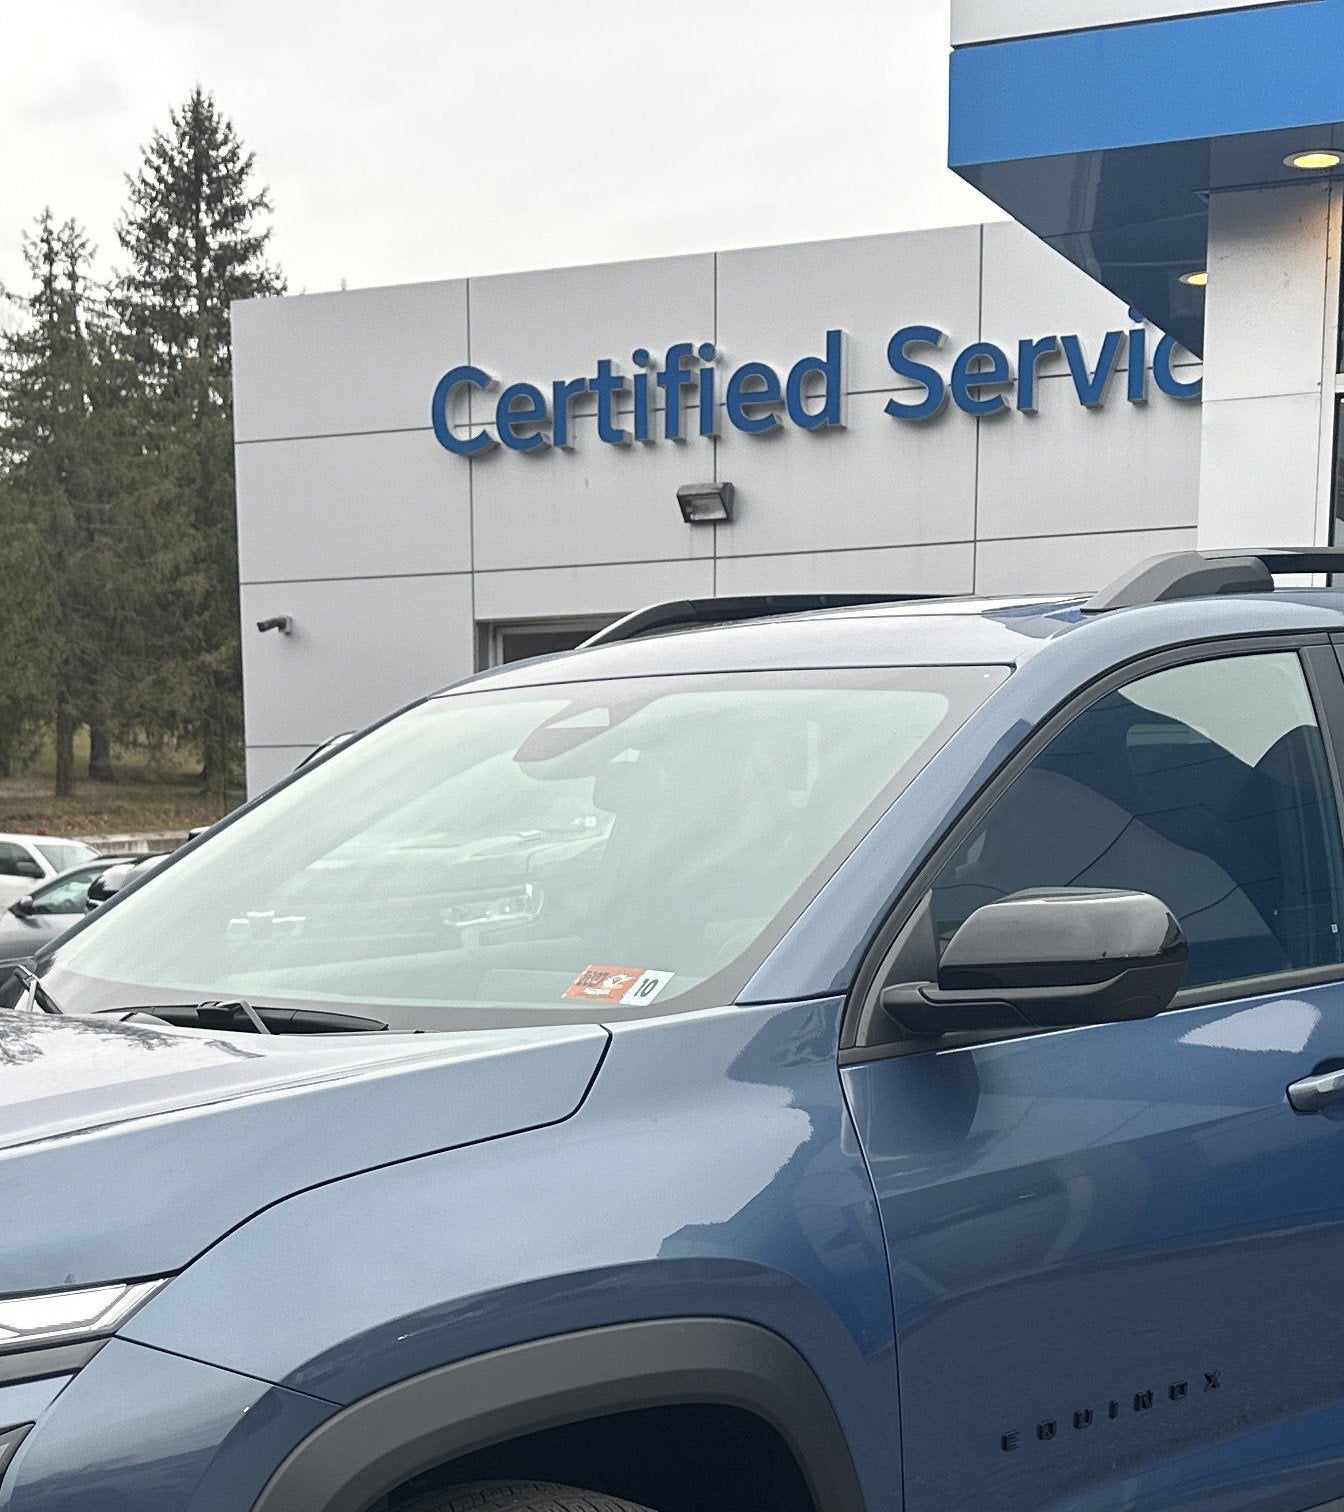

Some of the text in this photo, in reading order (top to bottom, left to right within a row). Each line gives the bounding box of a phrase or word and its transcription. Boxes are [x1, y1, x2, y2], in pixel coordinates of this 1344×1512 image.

[431, 306, 1202, 457] Certified Servic
[634, 977, 660, 998] 10
[1000, 1369, 1222, 1451] EQUINOX
